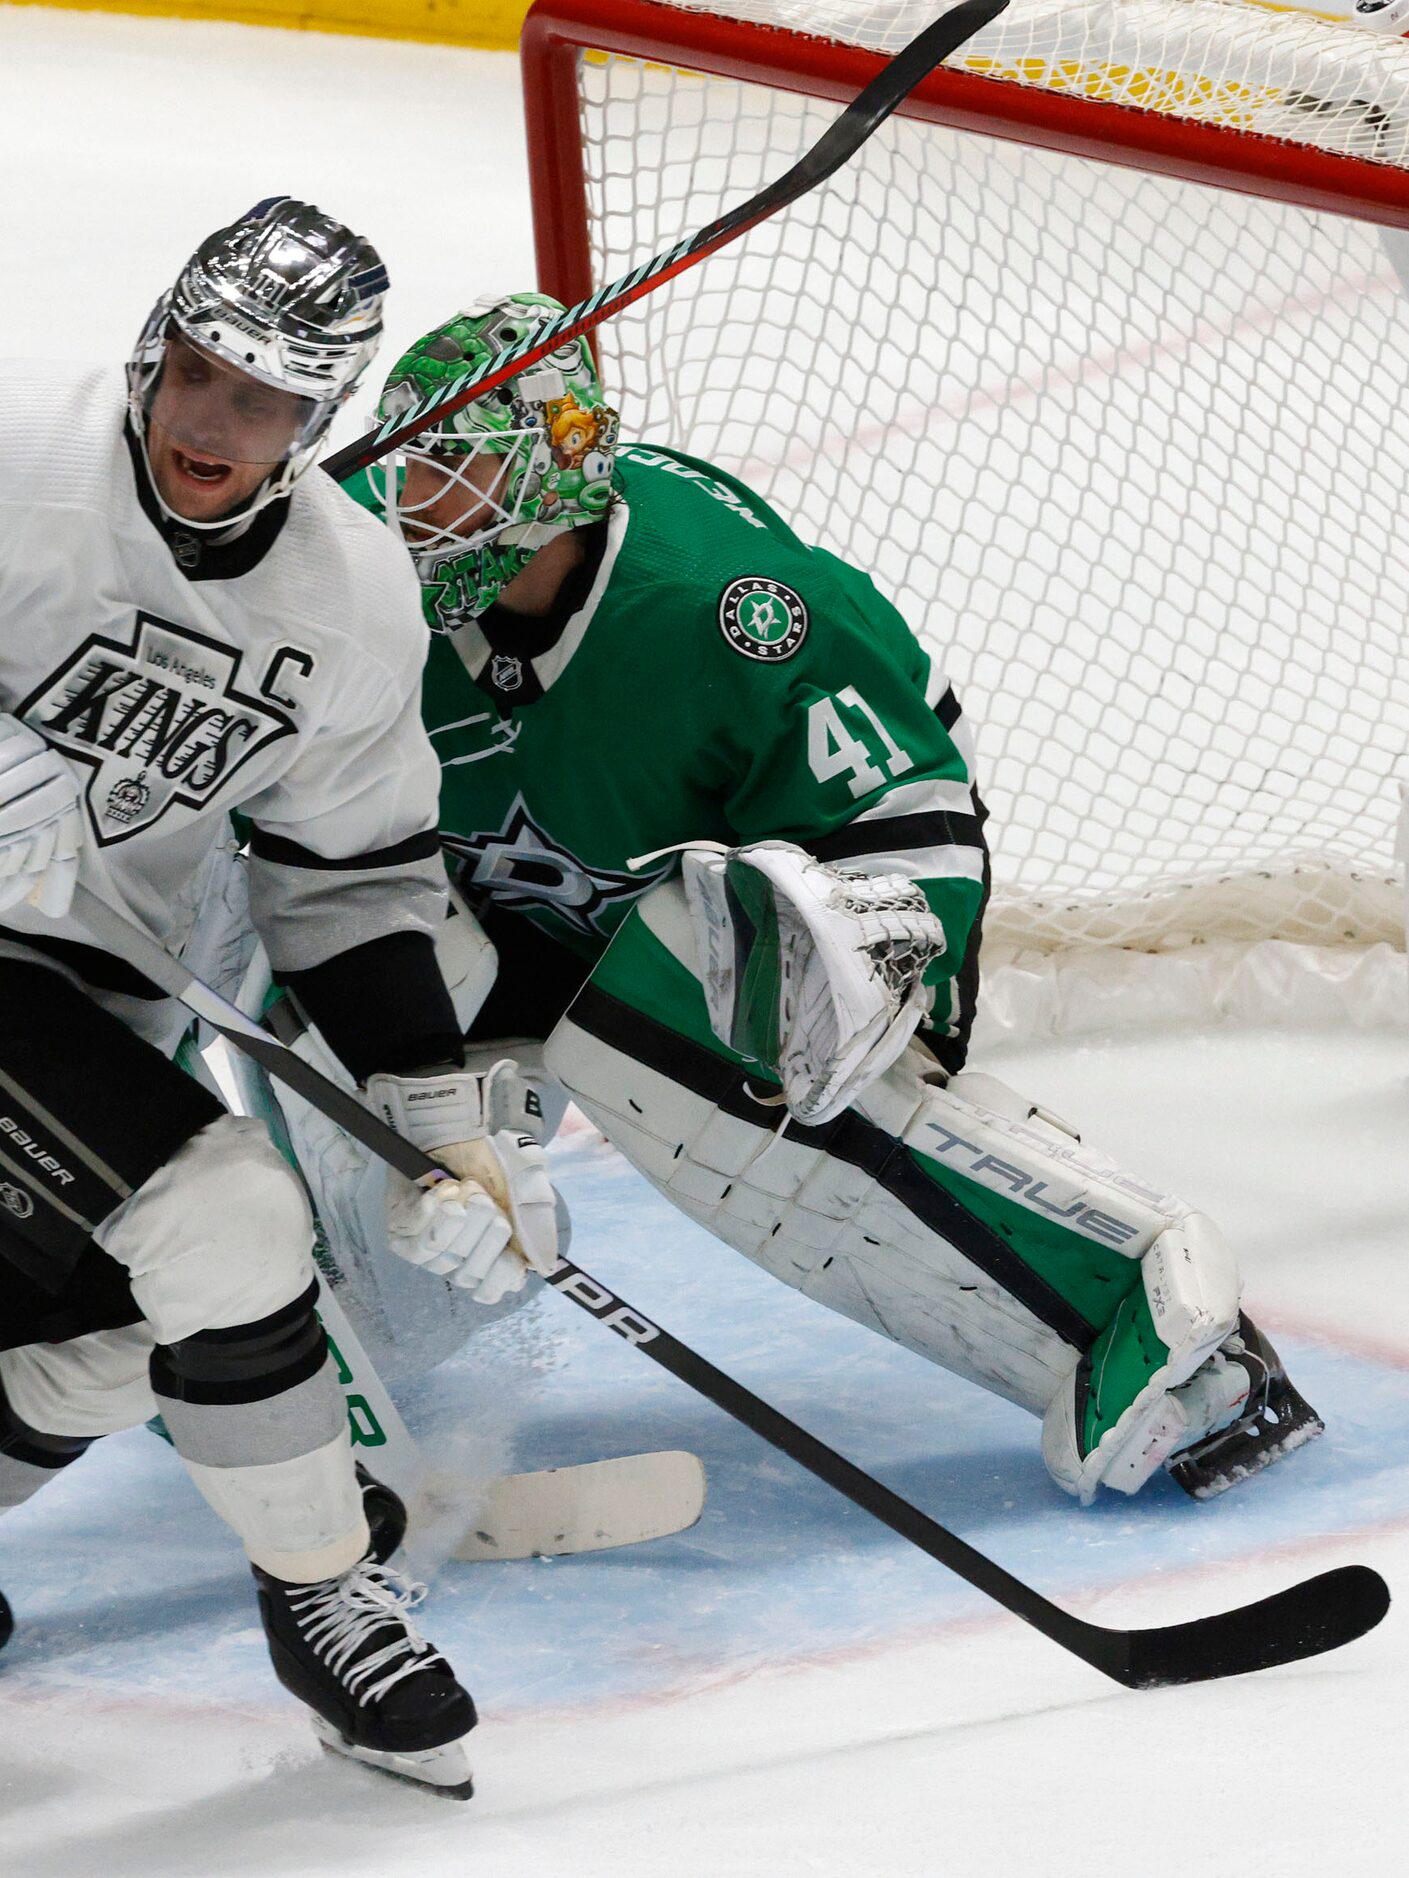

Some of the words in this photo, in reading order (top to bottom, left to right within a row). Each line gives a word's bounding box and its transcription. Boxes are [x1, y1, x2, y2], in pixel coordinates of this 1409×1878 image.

[725, 582, 778, 639] DALLAS
[758, 606, 802, 656] STARS
[146, 645, 169, 670] Los
[169, 657, 216, 690] Angeles
[259, 646, 314, 709] C
[42, 660, 259, 792] KINGS
[807, 684, 916, 800] 41
[407, 1088, 457, 1102] BAUER
[925, 1122, 1140, 1246] TRUE
